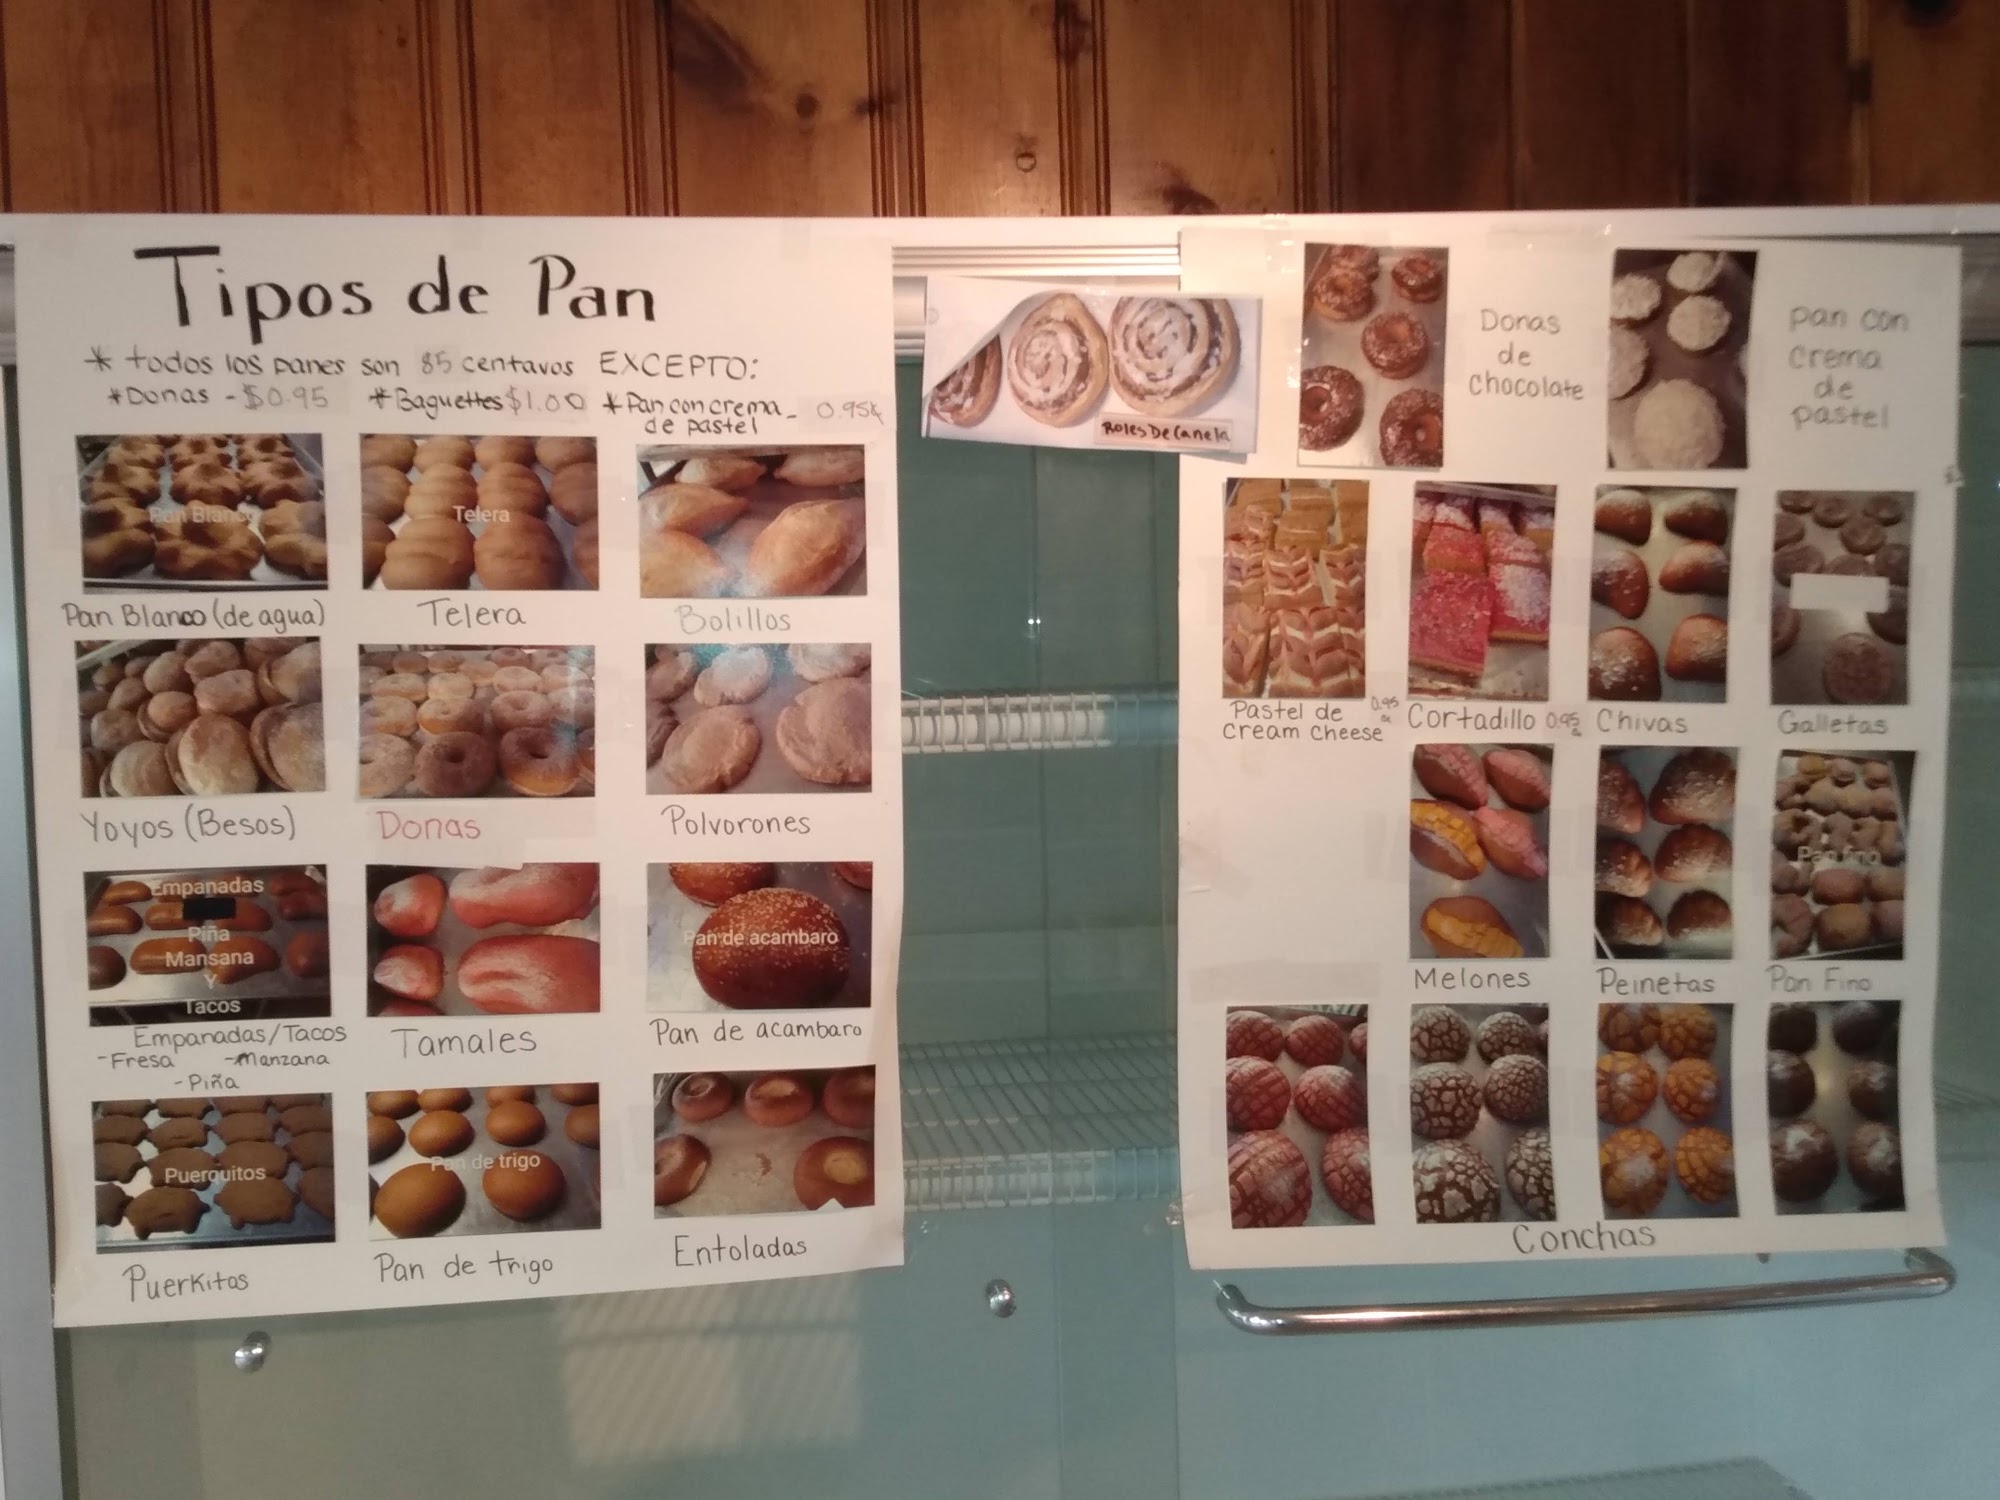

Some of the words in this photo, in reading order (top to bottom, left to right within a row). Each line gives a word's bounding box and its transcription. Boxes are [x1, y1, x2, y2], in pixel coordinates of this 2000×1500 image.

[134, 245, 372, 345] Tipos
[408, 255, 490, 314] de
[529, 254, 655, 322] Pan
[1481, 308, 1561, 335] Donas
[225, 354, 263, 375] los
[274, 356, 345, 375] panes
[361, 357, 399, 376] son
[421, 351, 451, 374] 85
[462, 355, 574, 376] centavos
[600, 352, 759, 380] EXCEPTO:
[1498, 342, 1531, 366] de
[506, 385, 586, 415] $1.00
[1814, 374, 1854, 400] de
[669, 398, 704, 414] con
[645, 417, 674, 435] de
[688, 417, 757, 436] pastel
[150, 507, 186, 523] Pan
[453, 505, 510, 523] Telera
[62, 603, 113, 628] Pan
[121, 604, 206, 628] Blanco
[213, 598, 253, 629] (de
[258, 599, 324, 633] agua)
[417, 598, 526, 628] Telera
[674, 605, 791, 634] Bolillos
[1230, 700, 1303, 721] Pastel
[1315, 703, 1343, 722] de
[1408, 703, 1535, 730] Cortadillo
[1597, 708, 1688, 734] Chivas
[1778, 709, 1888, 735] Galletas
[80, 811, 173, 848] Yoyos
[185, 803, 296, 842] (Besos)
[377, 811, 481, 839] Donas
[661, 804, 810, 835] Polvorones
[151, 877, 264, 898] Empanadas
[188, 927, 230, 943] Piña
[684, 930, 717, 946] Pan
[723, 930, 744, 945] de
[750, 929, 838, 945] acambaro
[166, 951, 254, 967] Mansana
[1414, 967, 1530, 989] Melones
[1595, 967, 1715, 996] Peinetas
[1765, 964, 1812, 993] Pan
[1824, 967, 1872, 992] Fino
[186, 1000, 241, 1014] Tacos
[391, 1029, 536, 1058] Tamales
[650, 1018, 698, 1045] Pan
[714, 1019, 744, 1041] de
[757, 1021, 861, 1039] acambaro
[165, 1167, 266, 1184] Puerquitos
[431, 1156, 466, 1171] Pan
[472, 1154, 494, 1169] de
[499, 1154, 540, 1172] trigo
[674, 1233, 807, 1267] Entoladas
[1513, 1221, 1656, 1254] Conchas
[374, 1253, 423, 1282] Pan
[444, 1254, 476, 1277] de
[489, 1250, 553, 1284] trigo
[122, 1264, 249, 1302] Puerkitos
